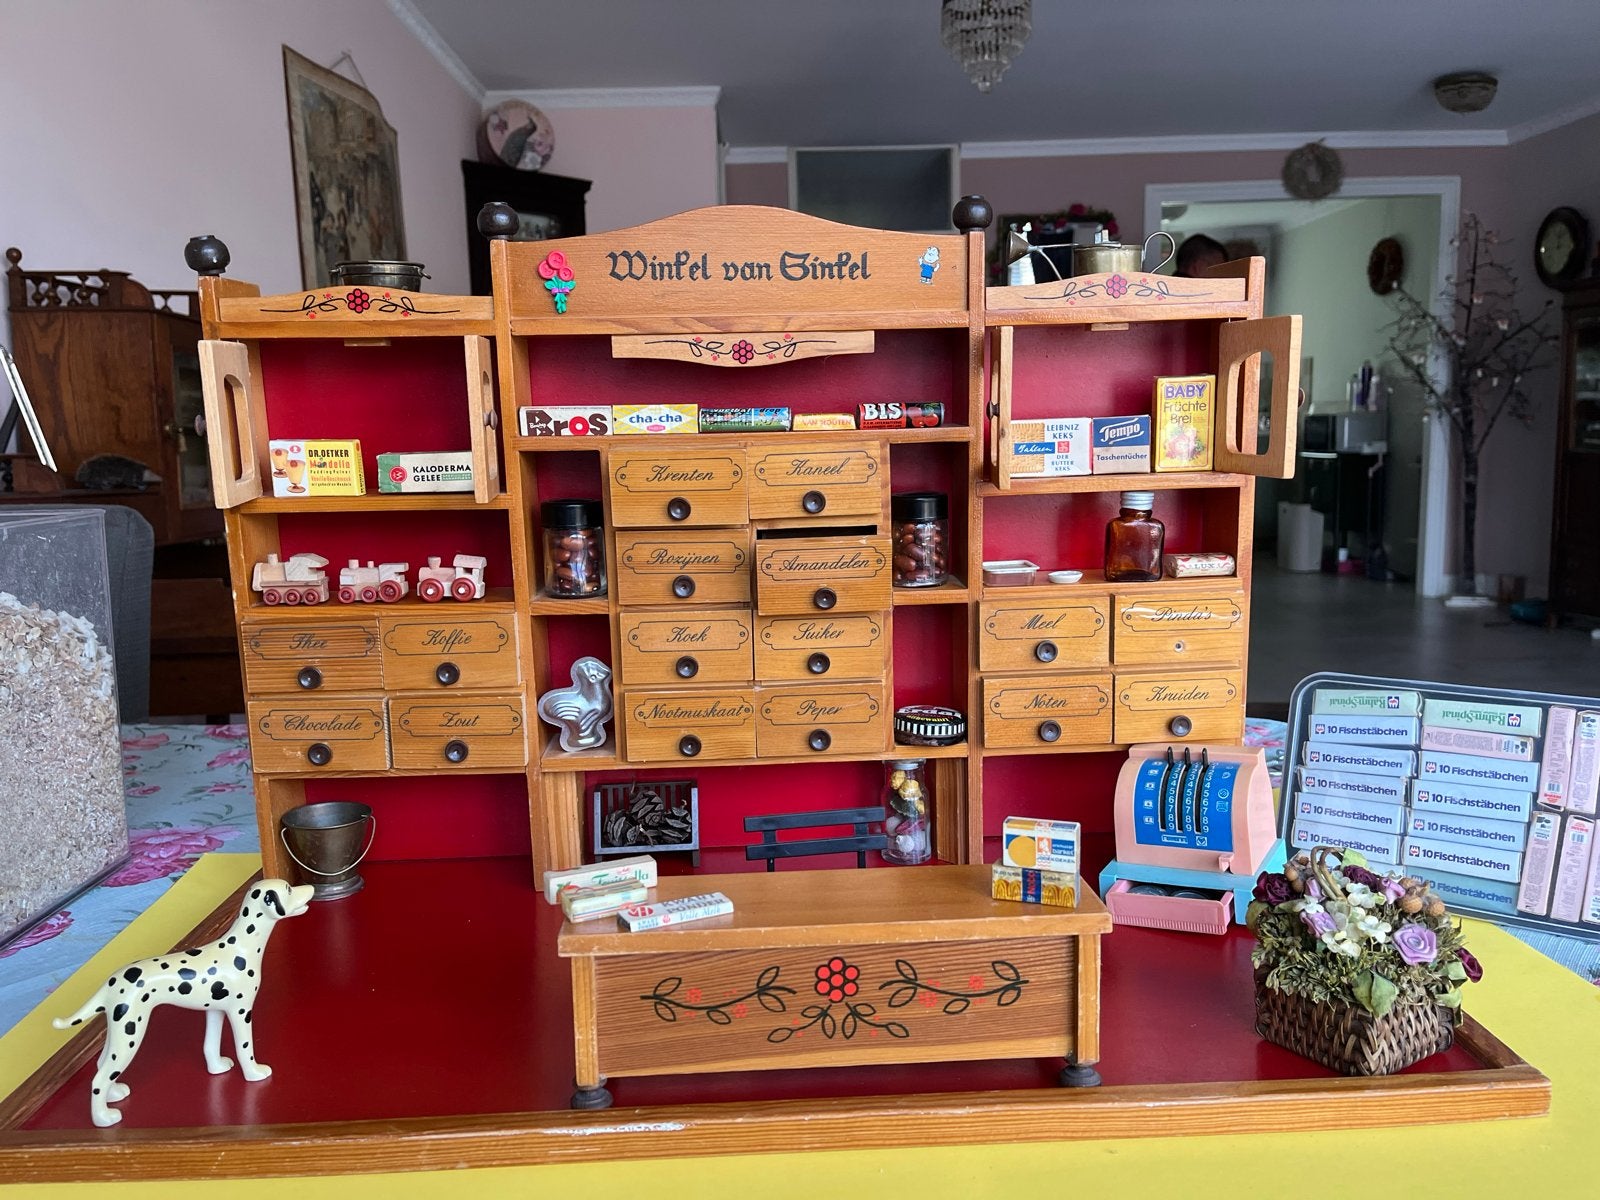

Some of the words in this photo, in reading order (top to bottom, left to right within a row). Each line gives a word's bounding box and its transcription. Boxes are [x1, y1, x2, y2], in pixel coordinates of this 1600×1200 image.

[606, 250, 712, 282] Winkel
[722, 258, 773, 281] van
[780, 250, 871, 282] Sinkel
[1165, 384, 1207, 400] BABY
[863, 403, 901, 420] BIS
[1164, 401, 1207, 412] Früchte
[629, 413, 682, 424] cha-cha
[1171, 414, 1192, 424] Brei
[1046, 424, 1079, 432] LEIBNIZ
[1100, 420, 1142, 443] Tempo
[1096, 453, 1147, 461] Taschentücher
[413, 465, 471, 473] KALODERMA
[646, 464, 714, 483] Krenten
[786, 457, 850, 476] Kaneel
[647, 548, 720, 570] Rozijnen
[779, 553, 869, 571] Amandelen
[1020, 614, 1066, 629] Meel
[1151, 606, 1212, 622] Pinda's
[666, 626, 708, 643] Koek
[793, 623, 844, 641] Suiker
[289, 633, 328, 650] Thee
[422, 629, 472, 653] Koffie
[1024, 694, 1068, 709] Noten
[1146, 685, 1209, 702] Kruiden
[648, 701, 743, 720] Nootmuskaat
[797, 700, 843, 721] Peper
[1442, 710, 1506, 726] Rahm-Spinat
[283, 715, 362, 731] Chocolade
[439, 711, 480, 728] Zout
[1338, 727, 1408, 736] Fischstäbchen
[1322, 754, 1332, 762] 10
[1333, 756, 1402, 769] Fischstäbchen
[1439, 764, 1450, 773] 10
[1452, 766, 1528, 783] Fischstäbchen
[1318, 779, 1327, 788] 10
[1328, 781, 1397, 796] Fischstäbchen
[1432, 794, 1442, 802] 10
[1444, 796, 1520, 812] Fischstäbchen
[1313, 806, 1323, 814] 10
[1324, 808, 1392, 824] Fischstäbchen
[1427, 822, 1438, 831] 10
[1440, 824, 1515, 842] Fischstäbchen
[1310, 833, 1320, 842] 10
[1321, 836, 1389, 855] Fischstäbchen
[1422, 849, 1432, 858] 10
[1434, 851, 1510, 871] Fischstäbchen
[662, 894, 714, 907] KWART
[1437, 881, 1513, 904] Fischstäbchen
[667, 899, 726, 913] PONDER
